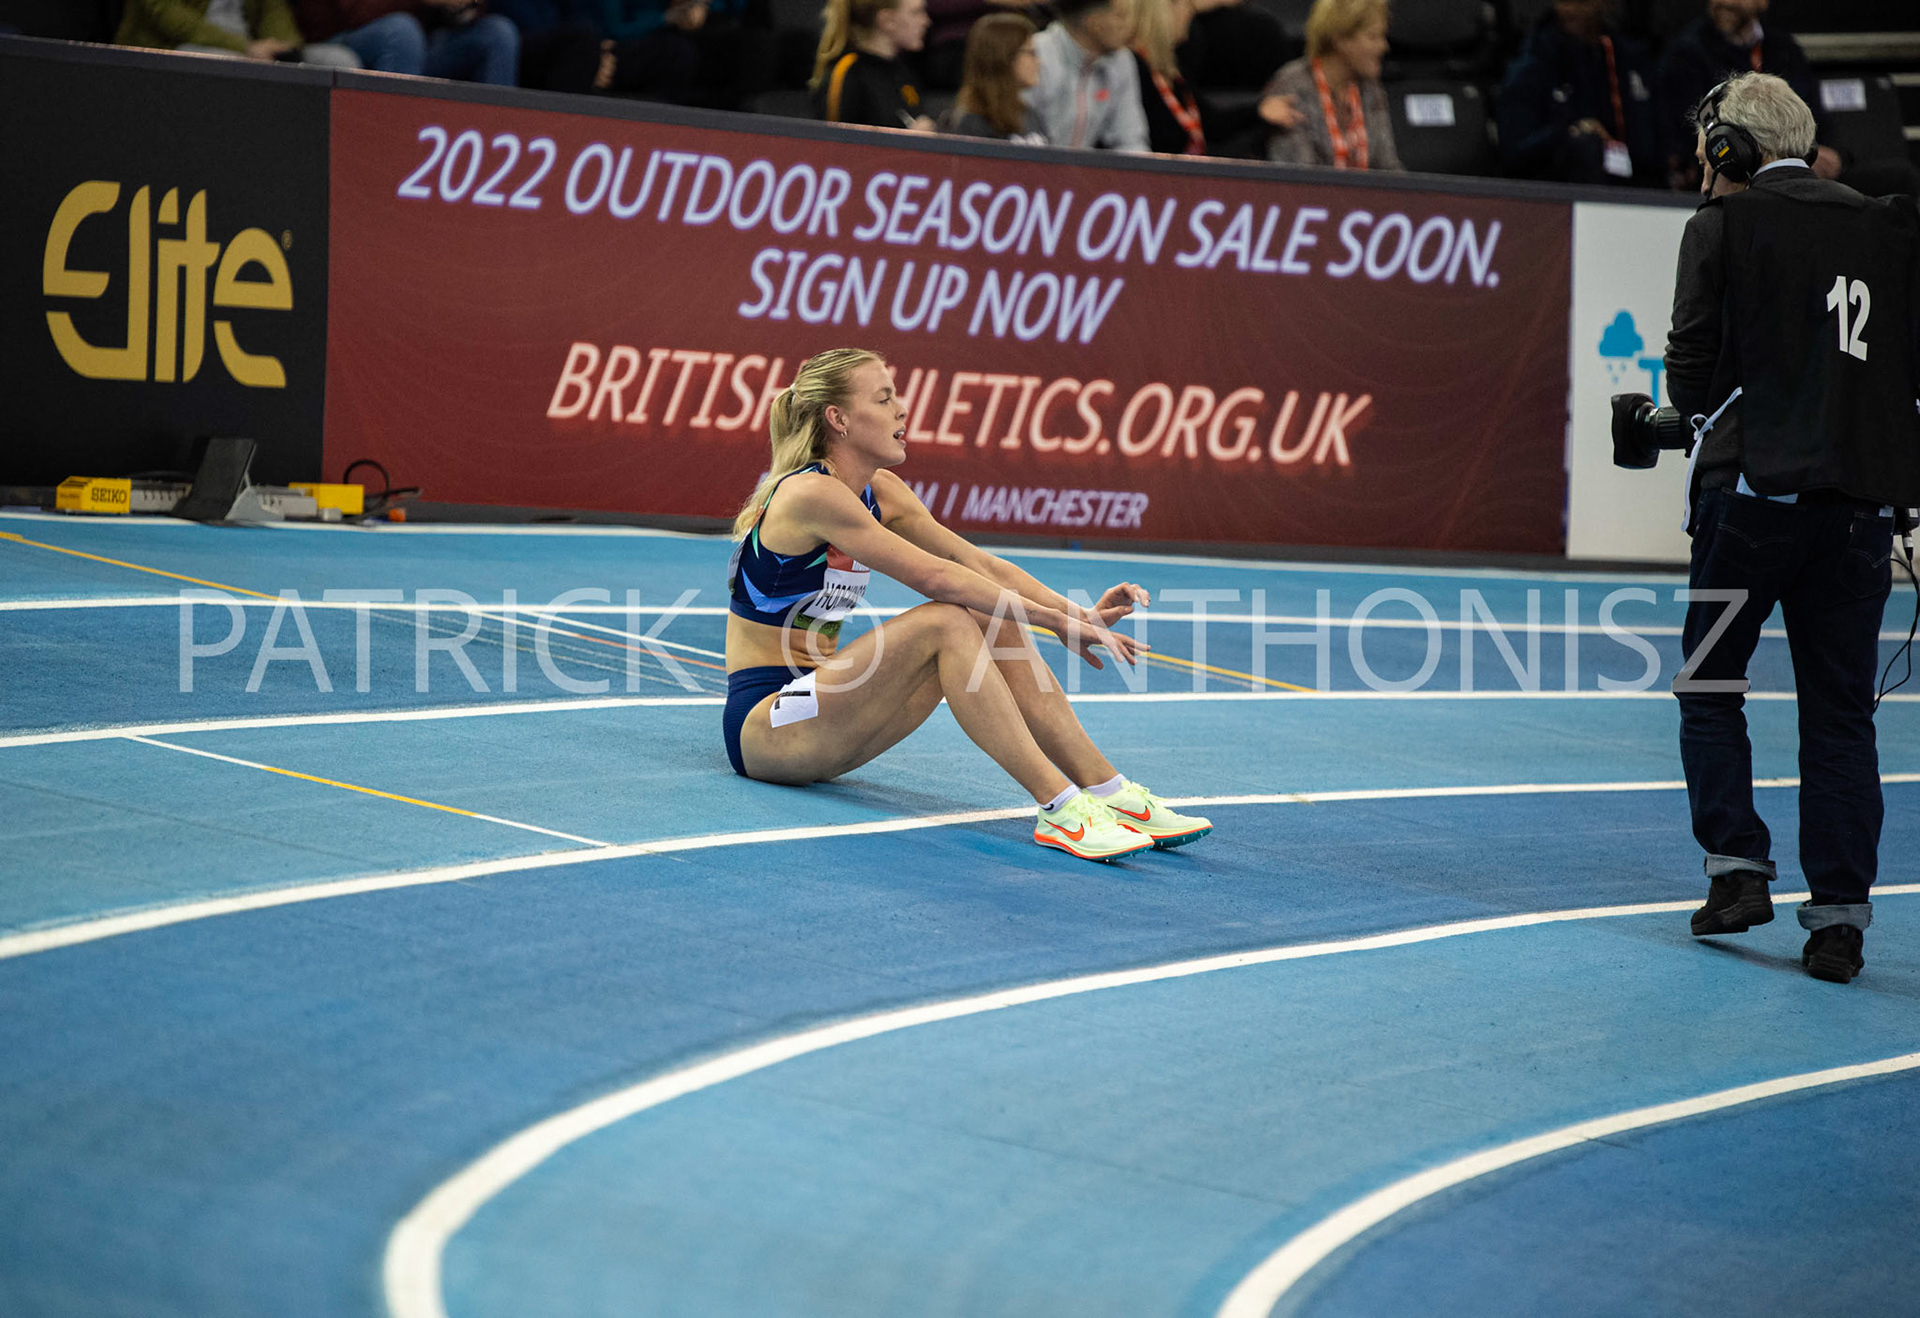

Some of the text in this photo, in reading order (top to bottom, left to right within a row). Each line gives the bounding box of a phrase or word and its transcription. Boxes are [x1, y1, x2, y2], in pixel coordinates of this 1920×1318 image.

[397, 126, 1502, 288] 2022 OUTDOOR SEASON ON SALE SOON.
[738, 248, 1125, 344] SIGN UP NOW
[1826, 275, 1871, 361] 12
[547, 342, 1372, 465] BRITISHHLETICS.ORG.UK
[91, 487, 127, 504] SEIKO
[961, 484, 1149, 529] MANCHESTER
